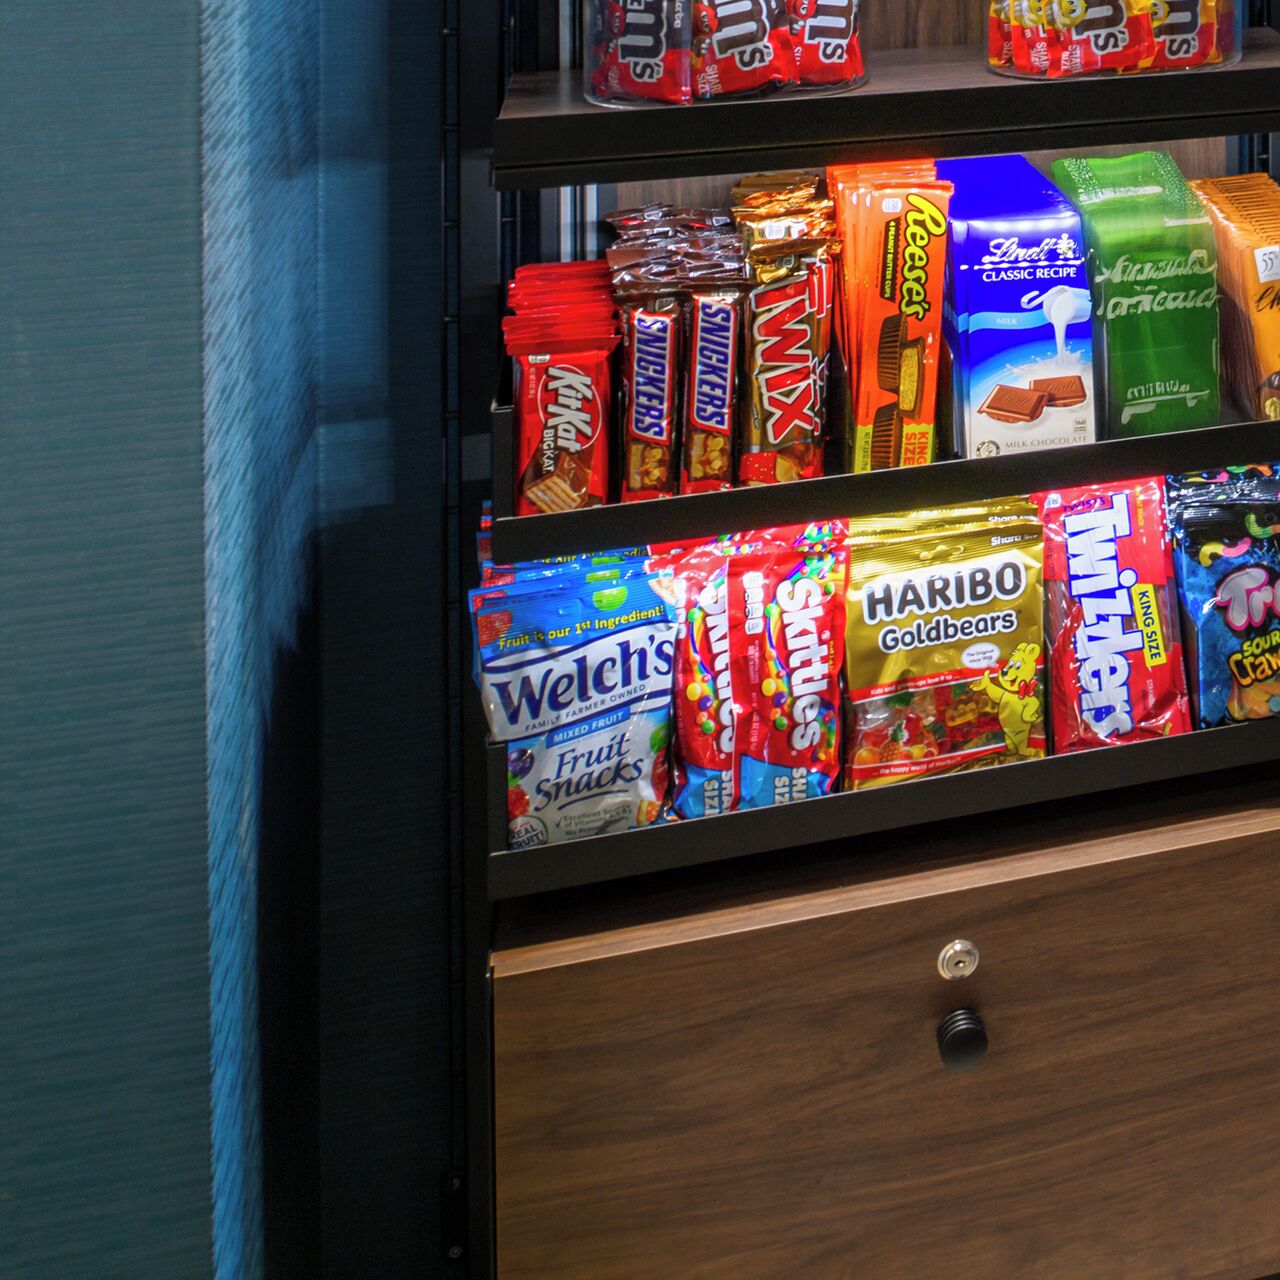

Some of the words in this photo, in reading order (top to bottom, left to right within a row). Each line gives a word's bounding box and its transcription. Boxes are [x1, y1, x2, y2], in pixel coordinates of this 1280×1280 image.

[900, 193, 946, 322] Reese's
[982, 268, 1034, 282] CLASSIC
[1036, 267, 1077, 279] RECIPE
[633, 312, 670, 442] SNICKERS
[694, 300, 736, 430] SNICKERS
[750, 270, 816, 446] TWIX
[903, 432, 917, 466] SIZE
[916, 431, 930, 466] KING
[1005, 440, 1028, 449] MILK
[1030, 435, 1088, 447] CHOCOLATE
[1061, 496, 1106, 512] TWISTS
[866, 561, 1023, 621] HARIBO
[1064, 492, 1145, 739] Twizzlers
[1137, 590, 1155, 628] KING
[497, 631, 533, 652] Fruit
[533, 630, 545, 643] is
[549, 625, 573, 641] our
[575, 620, 592, 635] 1st
[594, 604, 665, 631] Ingredient!
[880, 612, 1015, 652] Goldbears
[1145, 630, 1161, 661] SIZE
[490, 633, 675, 726] Welch's
[775, 577, 830, 753] Skittles
[524, 714, 562, 733] FAMILY
[565, 699, 607, 720] FARMER
[609, 683, 647, 704] OWNED
[552, 722, 592, 744] MIXED
[591, 710, 624, 731] FRUIT
[556, 733, 631, 782] Fruit
[534, 756, 645, 811] Snacks
